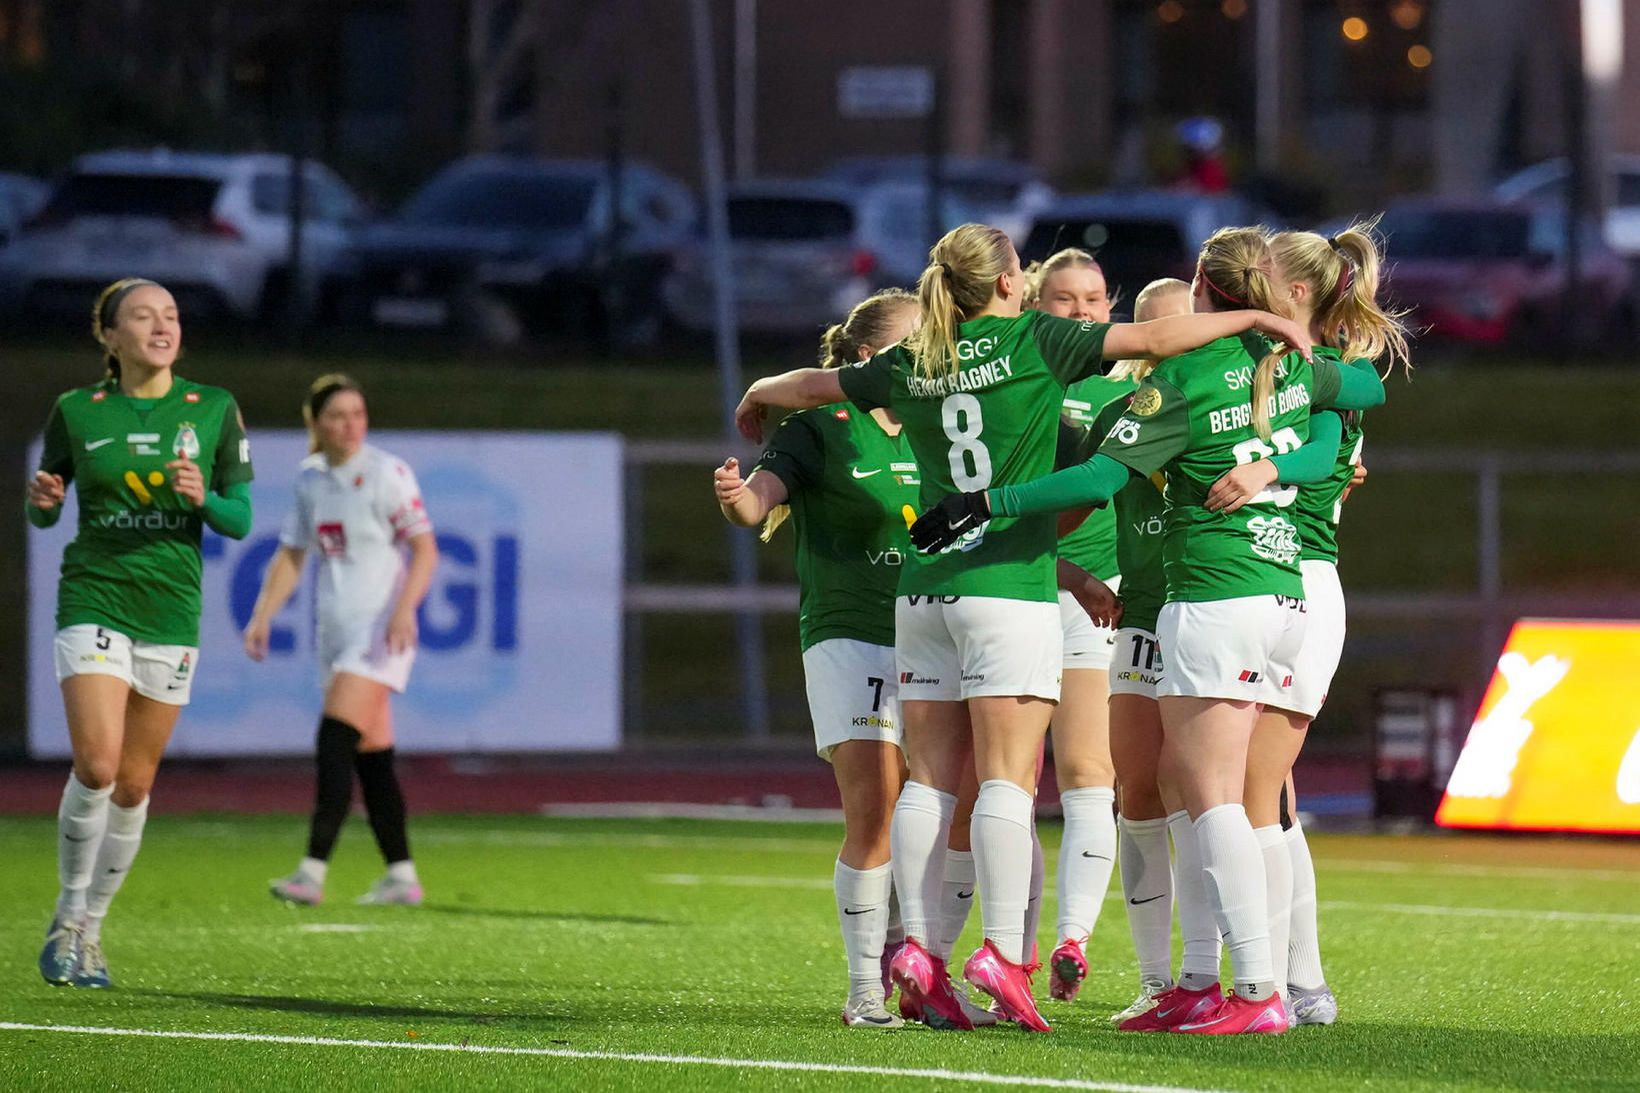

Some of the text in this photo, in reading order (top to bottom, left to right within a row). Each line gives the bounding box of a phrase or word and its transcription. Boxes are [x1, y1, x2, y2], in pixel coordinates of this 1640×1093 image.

[948, 355, 1013, 394] RAGNEY
[941, 393, 992, 493] 8
[96, 627, 111, 650] 5
[1131, 634, 1155, 670] 11
[867, 676, 884, 711] 7
